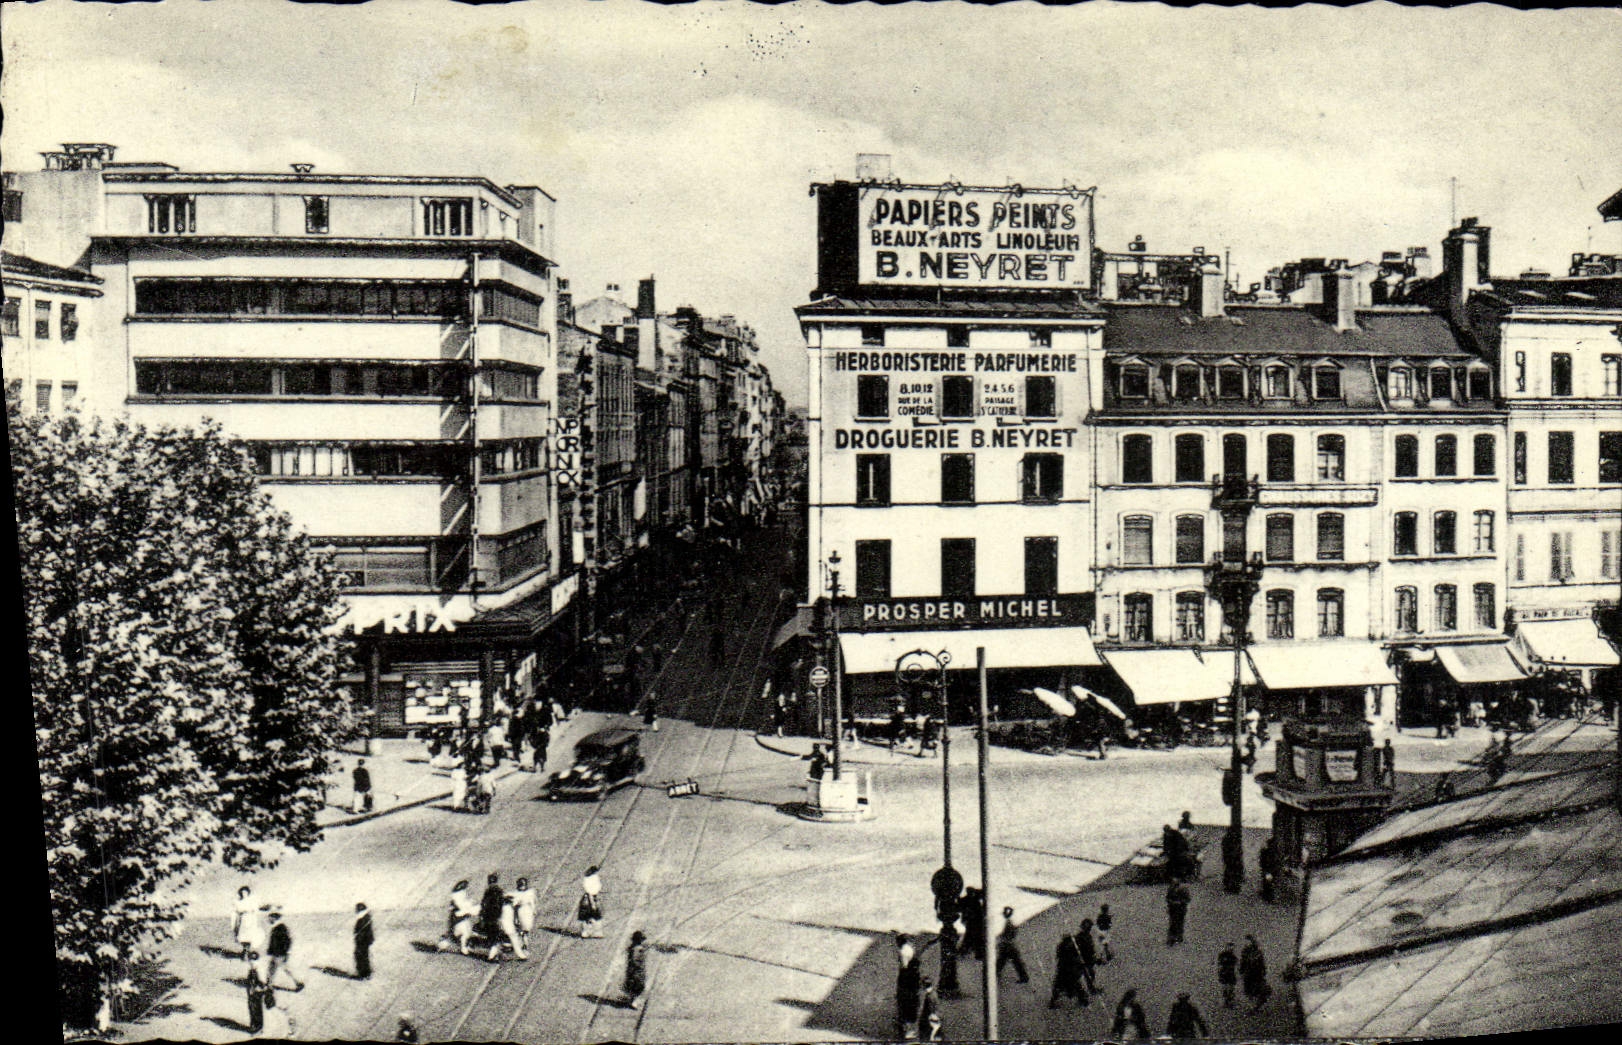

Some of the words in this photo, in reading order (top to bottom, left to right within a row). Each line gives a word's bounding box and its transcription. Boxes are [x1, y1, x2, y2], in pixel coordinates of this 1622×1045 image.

[875, 199, 981, 228] PAPIERS
[992, 202, 1076, 230] PEINTS
[871, 230, 983, 249] BEAUX-ARTS
[996, 232, 1080, 251] LINOLEUM
[835, 352, 966, 373] HERBORISTERIE
[974, 353, 1077, 373] PARFUMERIE
[912, 397, 921, 405] DE
[923, 396, 934, 405] LA
[834, 428, 959, 450] DROGUERIE
[862, 602, 966, 621] PROSPER
[979, 600, 1062, 618] MICHEL
